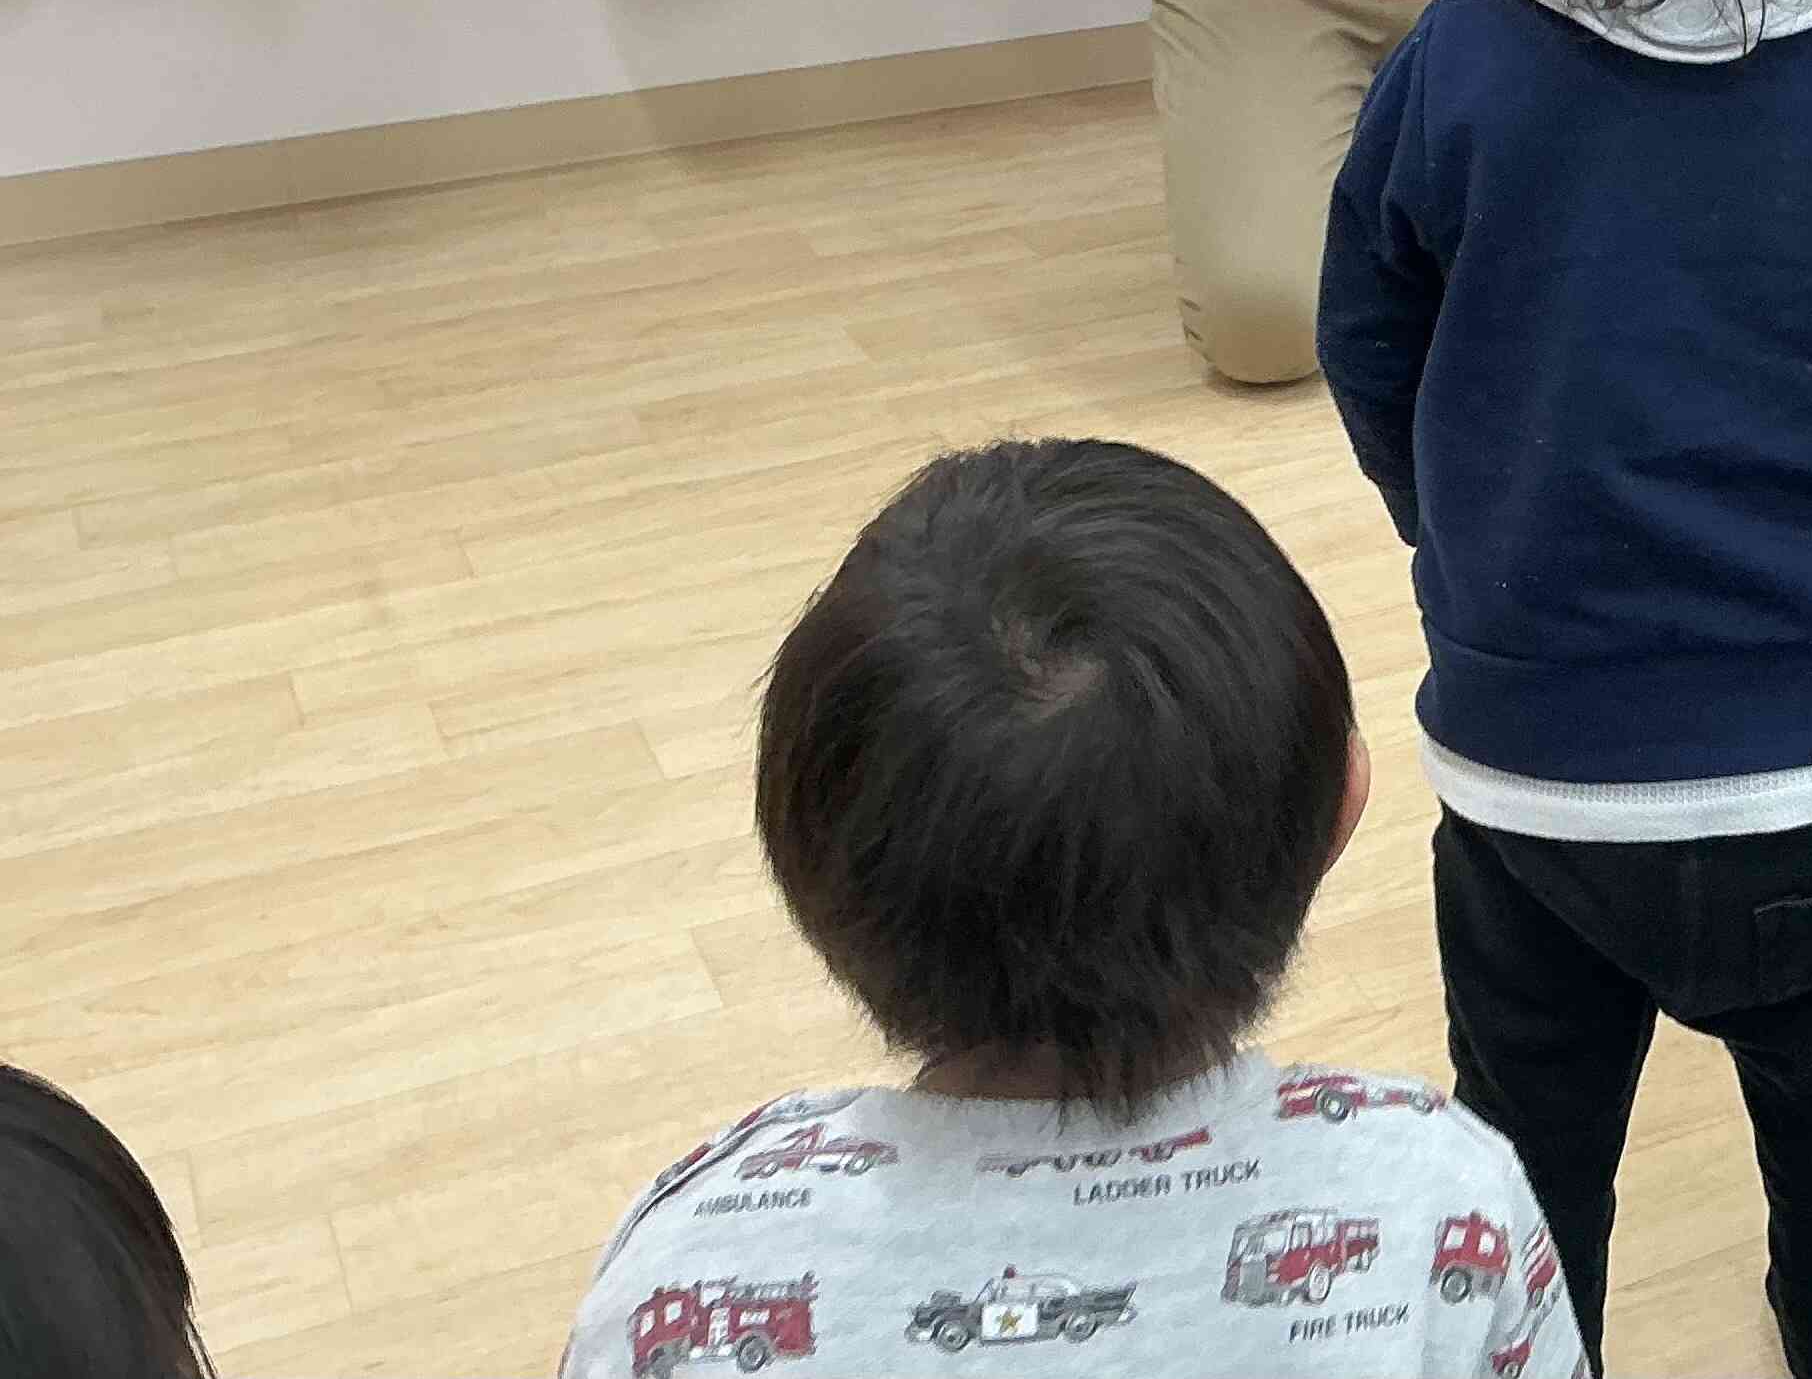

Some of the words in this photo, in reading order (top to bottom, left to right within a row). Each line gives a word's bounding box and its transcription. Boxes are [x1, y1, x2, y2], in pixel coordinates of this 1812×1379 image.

[693, 1187, 814, 1218] AMBULANCE
[1072, 1173, 1172, 1206] LADDER
[1182, 1156, 1263, 1193] TRUCK
[1289, 1314, 1337, 1344] FIRE
[1344, 1301, 1411, 1335] TRUCK
